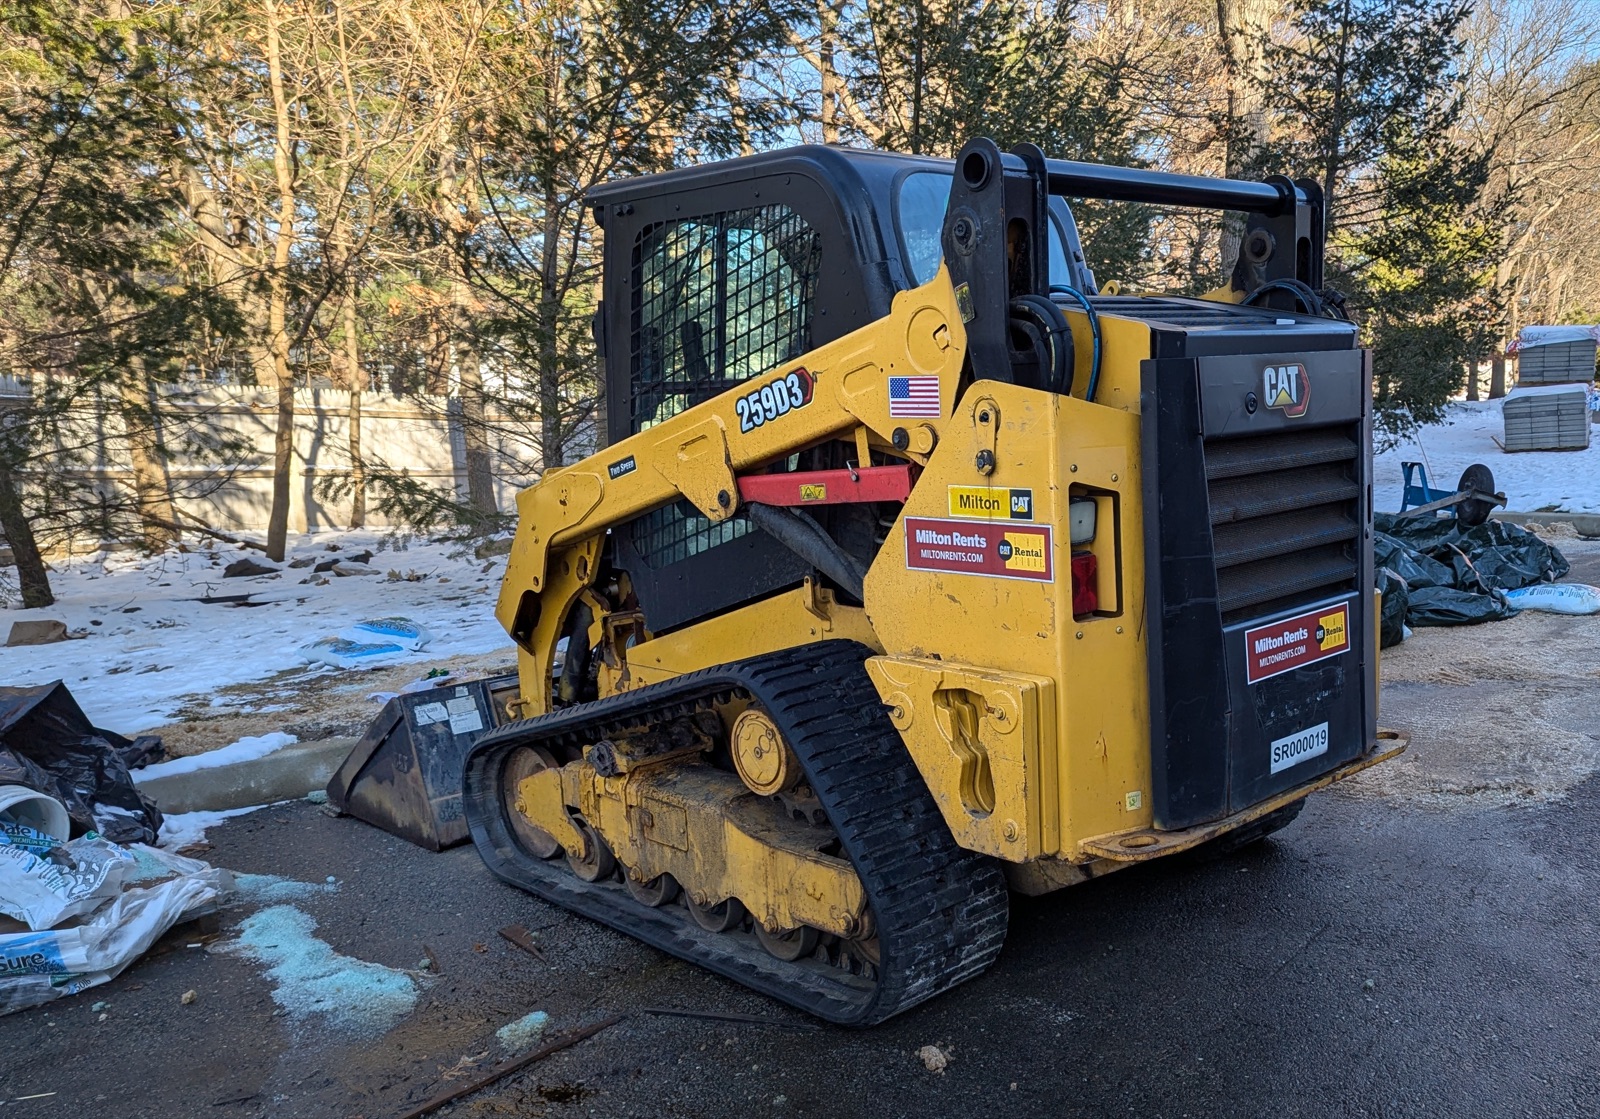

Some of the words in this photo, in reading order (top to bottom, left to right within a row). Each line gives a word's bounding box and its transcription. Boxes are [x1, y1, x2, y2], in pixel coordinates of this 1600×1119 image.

[1264, 366, 1298, 406] CAT
[736, 372, 804, 433] 259D3
[959, 494, 1000, 510] Milton
[1011, 496, 1029, 512] CAT
[915, 529, 951, 546] Milton
[952, 531, 987, 548] Rents
[920, 549, 984, 563] MILTONRENTS.COM
[999, 544, 1011, 556] CAT
[1014, 546, 1043, 558] Rental
[1255, 636, 1284, 654] Milton
[1284, 627, 1309, 644] Rents
[1325, 624, 1344, 637] Rental
[1259, 644, 1307, 668] MILTONRENTS.COM
[1273, 729, 1327, 763] SR000019
